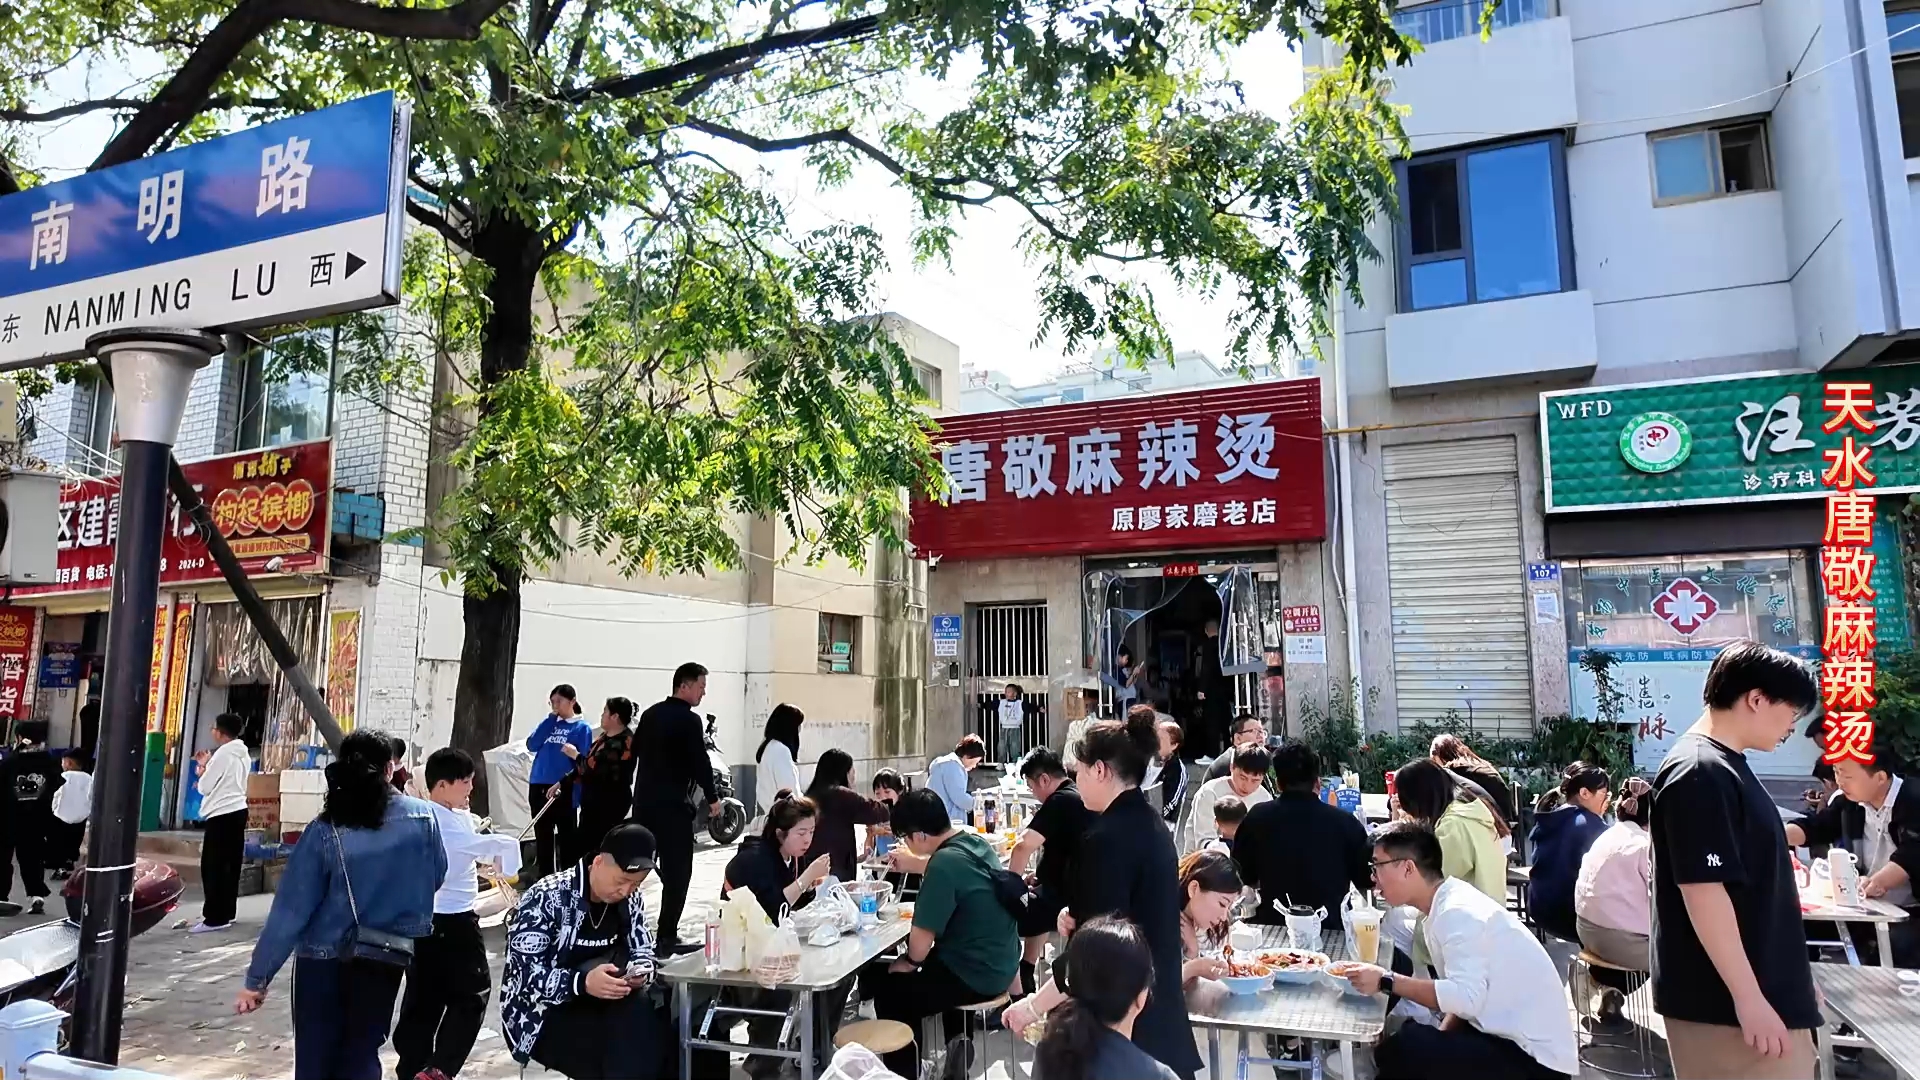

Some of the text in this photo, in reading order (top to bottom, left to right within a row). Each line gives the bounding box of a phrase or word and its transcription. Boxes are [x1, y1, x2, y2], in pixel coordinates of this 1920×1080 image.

[30, 135, 313, 271] 南明路
[1, 252, 336, 343] 东 NANMING LU 西
[1556, 399, 1612, 421] WFD
[939, 413, 1281, 505] 唐敬麻辣烫
[1743, 469, 1838, 491] 诊疗科
[216, 491, 311, 526] 枸杞槟榔
[1111, 498, 1277, 531] 原廖家磨老店
